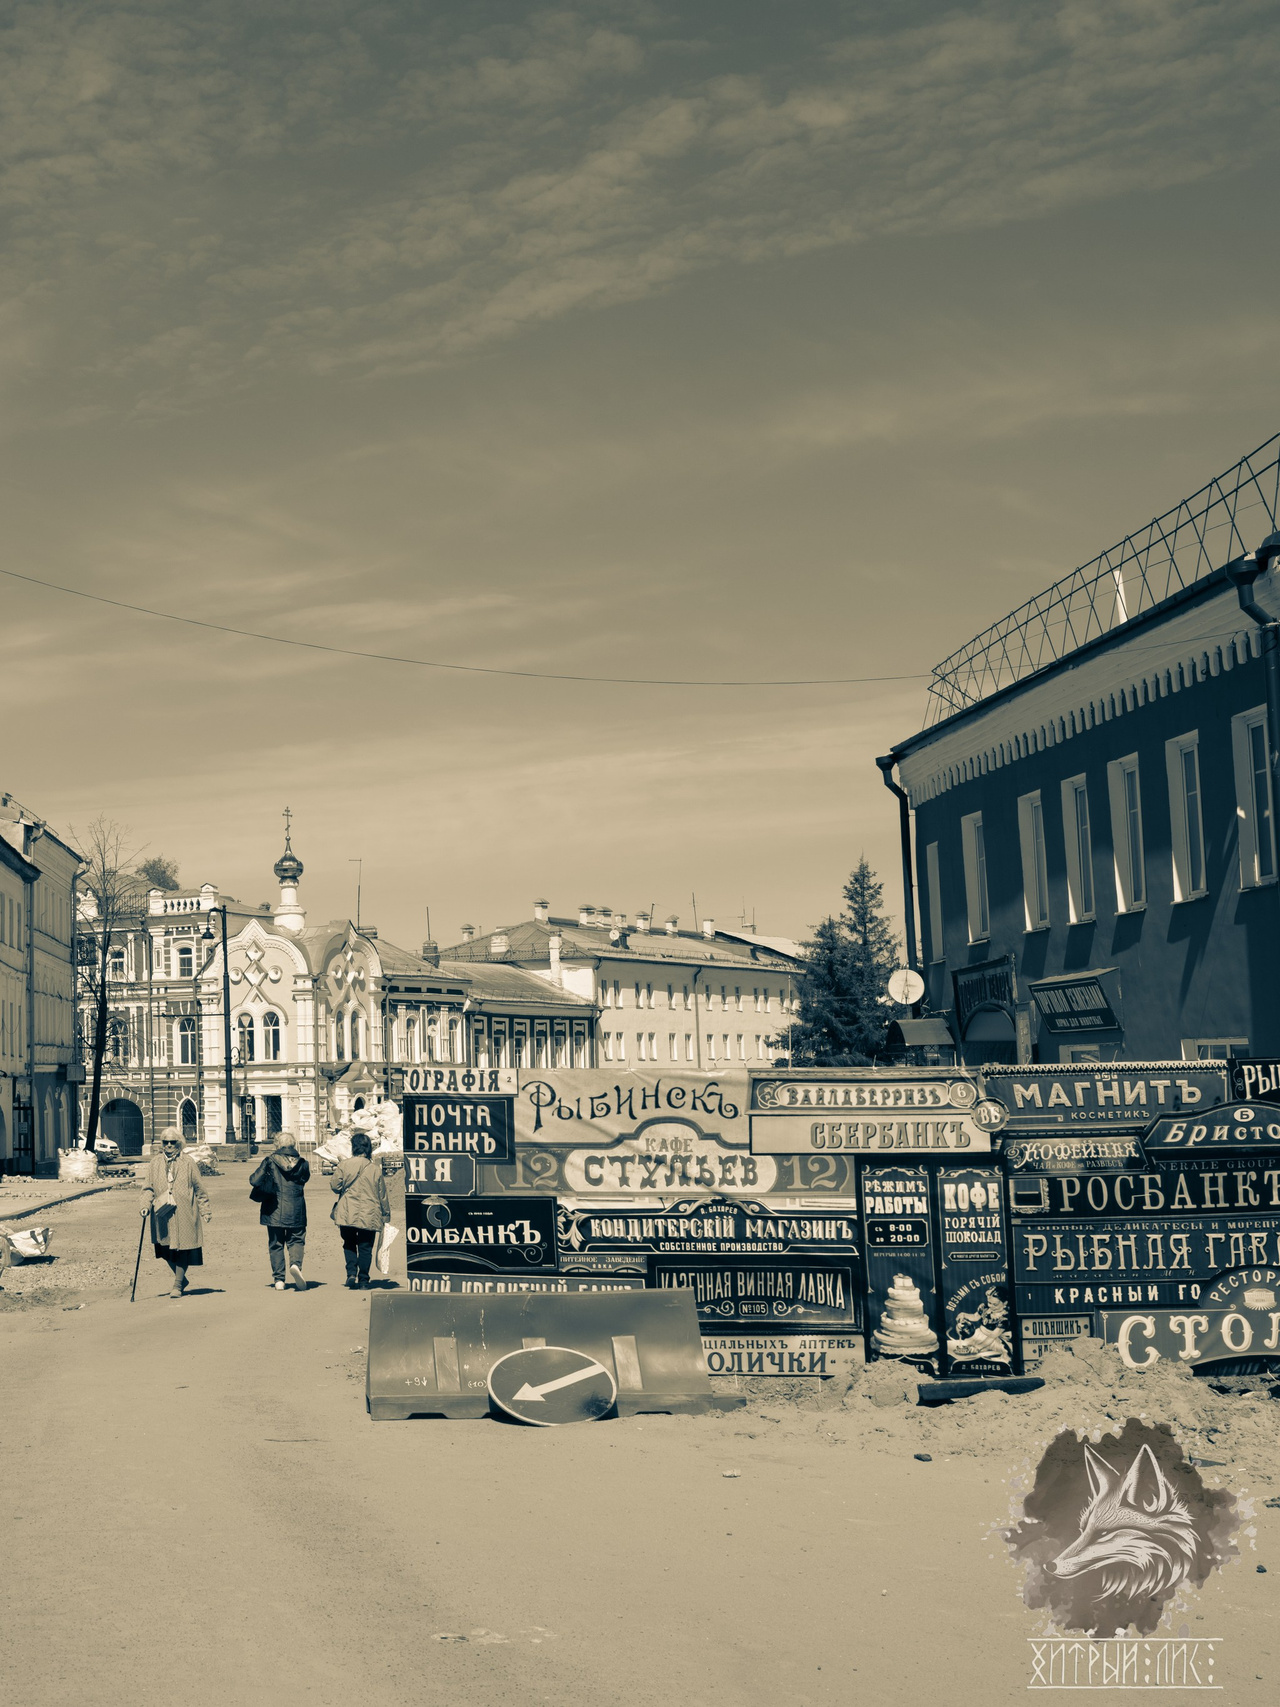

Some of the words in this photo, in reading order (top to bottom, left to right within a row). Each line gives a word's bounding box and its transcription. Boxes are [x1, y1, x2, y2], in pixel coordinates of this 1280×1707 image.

[1242, 1064, 1280, 1101] РЫ
[1013, 1079, 1202, 1109] МАГНИТЪ
[415, 1104, 492, 1126] ПОЧТА
[978, 1107, 1002, 1126] ВБ
[1071, 1110, 1150, 1121] КОСМЕТИКЪ
[415, 1132, 496, 1154] БАНКЪ
[645, 1137, 694, 1152] КАФЕ
[809, 1121, 971, 1149] СБЕРБАНКЪ
[1015, 1140, 1140, 1167] КОФЕЙНАЯ
[1227, 1159, 1276, 1169] GROUP
[510, 1152, 559, 1188] 12
[584, 1154, 758, 1189] СТУЛЬЕВ
[783, 1155, 838, 1189] 12
[865, 1196, 928, 1214] РАБОТЫ
[943, 1181, 1001, 1213] КОФЕ
[407, 1220, 542, 1245] ОМБАНКЪ
[745, 1219, 854, 1240] МАГАЗИНЪ
[889, 1224, 912, 1232] 8-00
[890, 1234, 920, 1242] 20-00
[945, 1231, 1002, 1244] ШОКОЛАД
[659, 1241, 716, 1252] СОБСТВЕННОЕ
[720, 1241, 784, 1252] ПРОИЗВОДСТВО
[1023, 1233, 1192, 1271] РЫБНАЯ
[980, 1272, 1006, 1285] СОБОЙ
[1210, 1269, 1280, 1303] РЕСТОР
[737, 1272, 793, 1299] ВИННАЯ
[797, 1273, 846, 1310] ЛАВКА
[1054, 1285, 1159, 1304] КРАСНЫЙ
[1178, 1284, 1201, 1301] ГО
[798, 1339, 856, 1350] АПТЕКЪ
